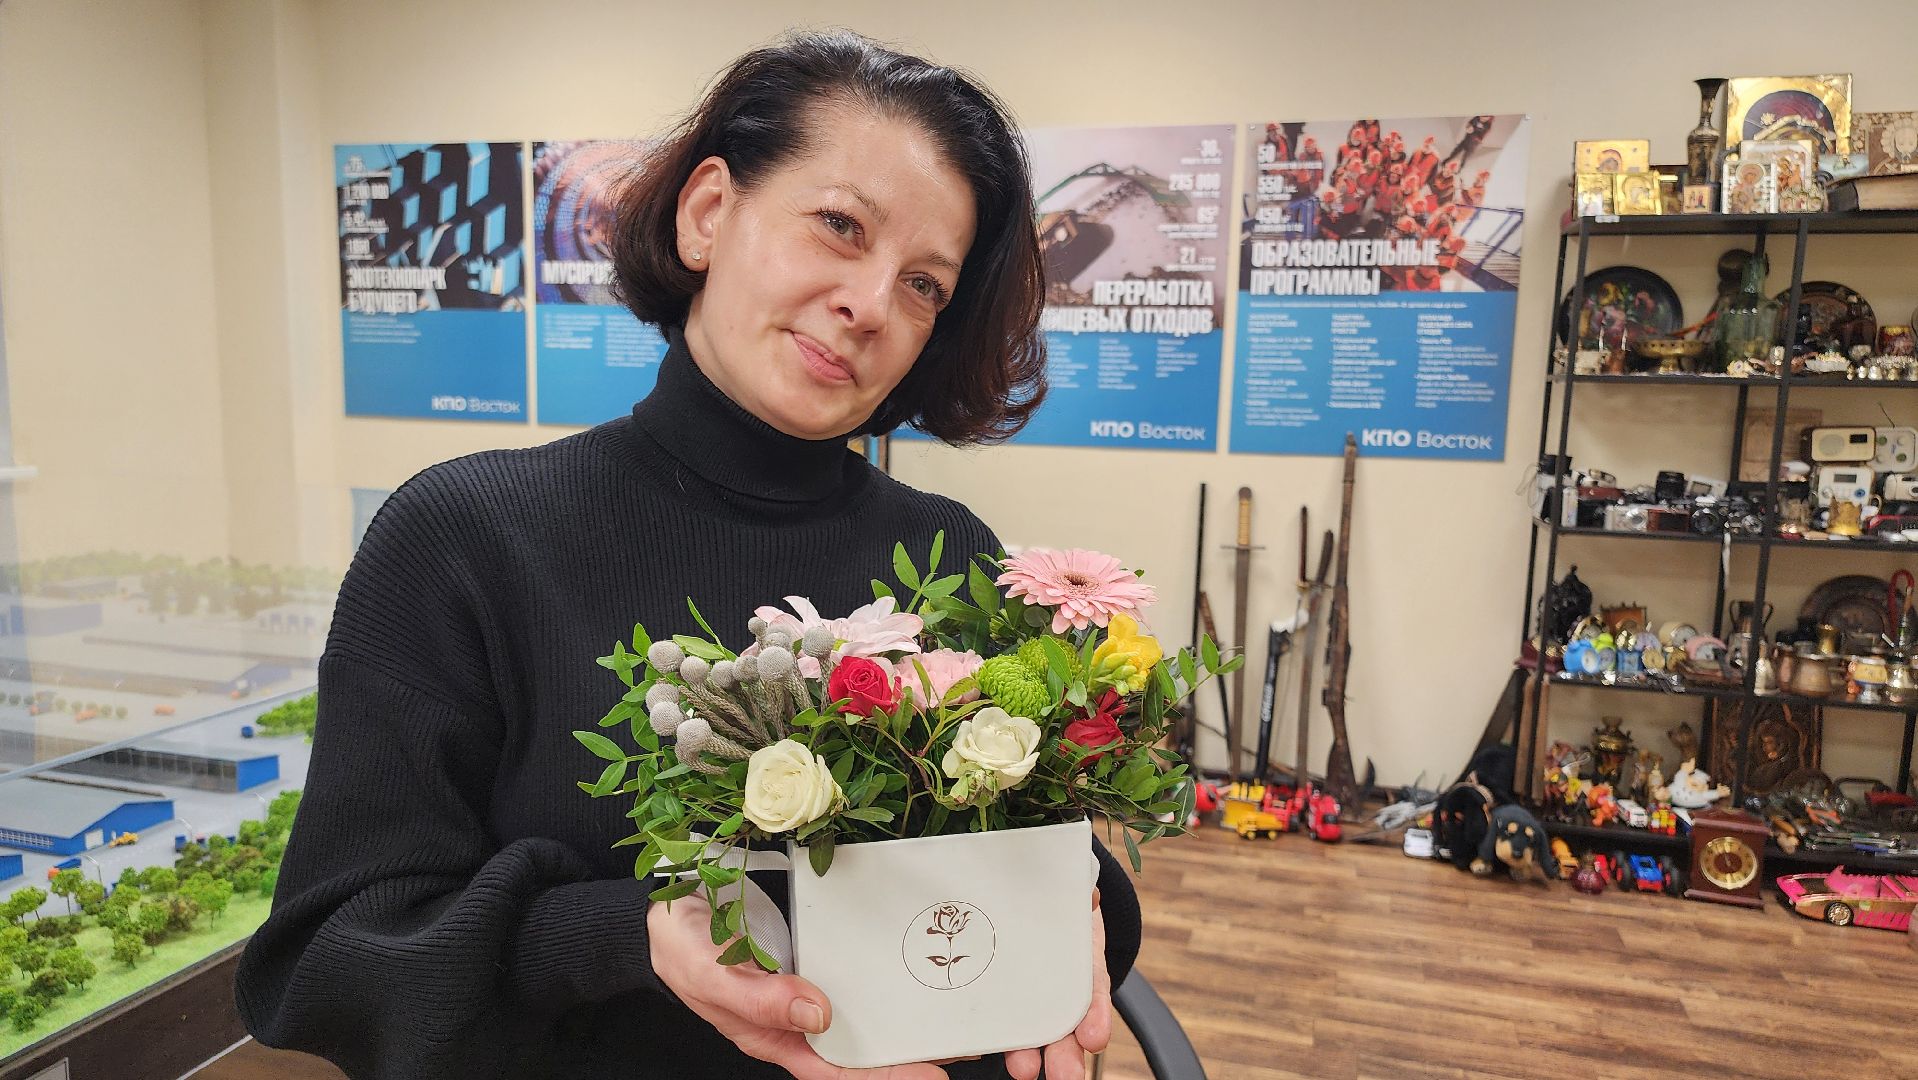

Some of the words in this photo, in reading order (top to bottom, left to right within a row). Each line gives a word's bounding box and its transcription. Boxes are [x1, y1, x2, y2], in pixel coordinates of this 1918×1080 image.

[1250, 239, 1440, 267] ОБРАЗОВАТЕЛЬНЫЕ
[346, 266, 447, 290] ЭКОТЕХНОПАРК
[1250, 268, 1381, 296] ПРОГРАММЫ
[347, 290, 418, 315] БУДУЩЕГО
[1092, 280, 1214, 306] ПЕРЕРАБОТКА
[1130, 308, 1214, 337] ОТХОДОВ
[431, 396, 466, 411] КПО
[468, 397, 521, 413] Восток
[1090, 420, 1134, 438] КПО
[1138, 422, 1206, 442] Восток
[1361, 428, 1411, 448] КПО
[1416, 431, 1493, 451] Восток
